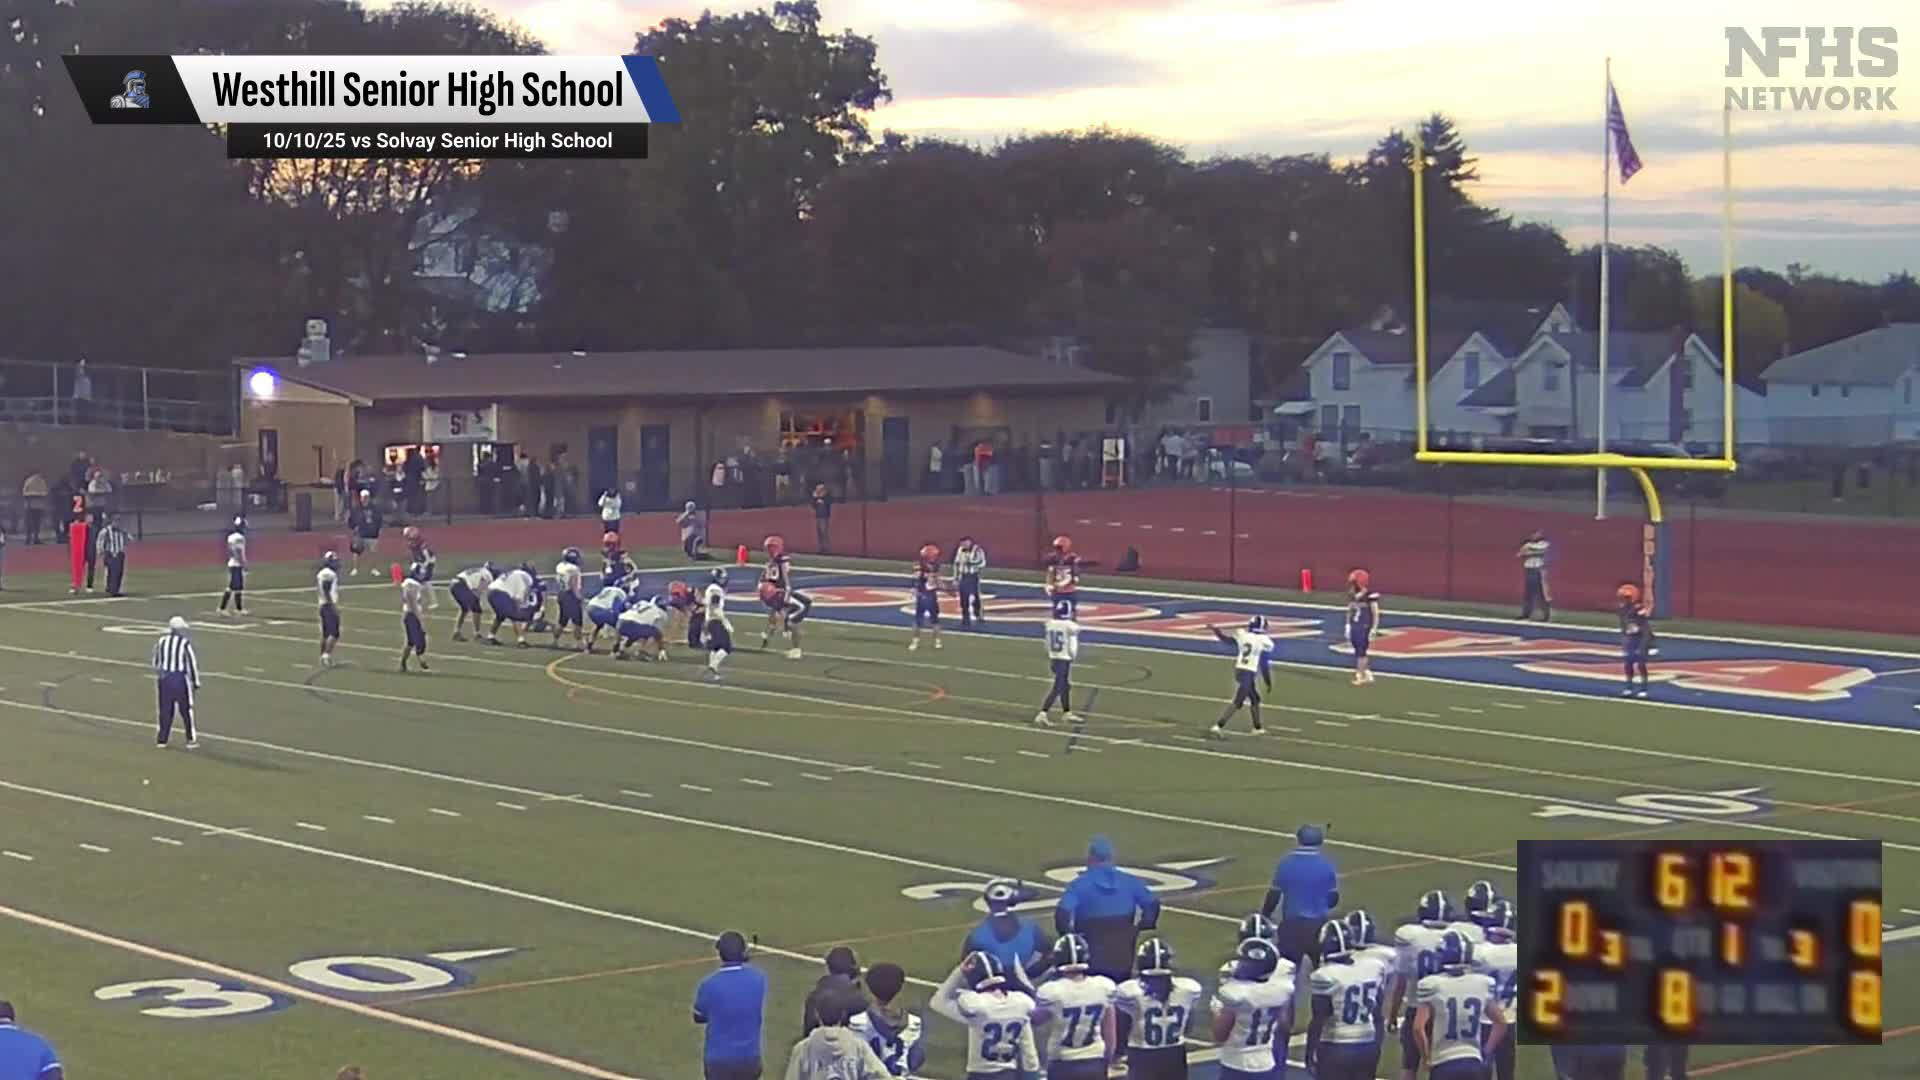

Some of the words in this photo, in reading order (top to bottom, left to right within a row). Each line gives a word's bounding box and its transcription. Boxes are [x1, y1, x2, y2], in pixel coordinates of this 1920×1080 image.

[1241, 642, 1252, 665] 2
[1531, 792, 1759, 826] 10
[1710, 853, 1752, 907] 12
[1562, 902, 1590, 956] 0
[1600, 930, 1624, 966] 3
[1724, 923, 1741, 966] 1
[1790, 930, 1816, 967] 3
[1850, 902, 1882, 957] 0
[94, 956, 454, 1017] 30
[1342, 981, 1377, 1025] 65
[1533, 970, 1563, 1024] 2
[1660, 970, 1692, 1026] 8
[1850, 970, 1882, 1027] 8
[1062, 1006, 1102, 1049] 77
[1144, 1005, 1186, 1047] 62
[1445, 997, 1482, 1040] 13
[981, 1021, 1024, 1061] 23
